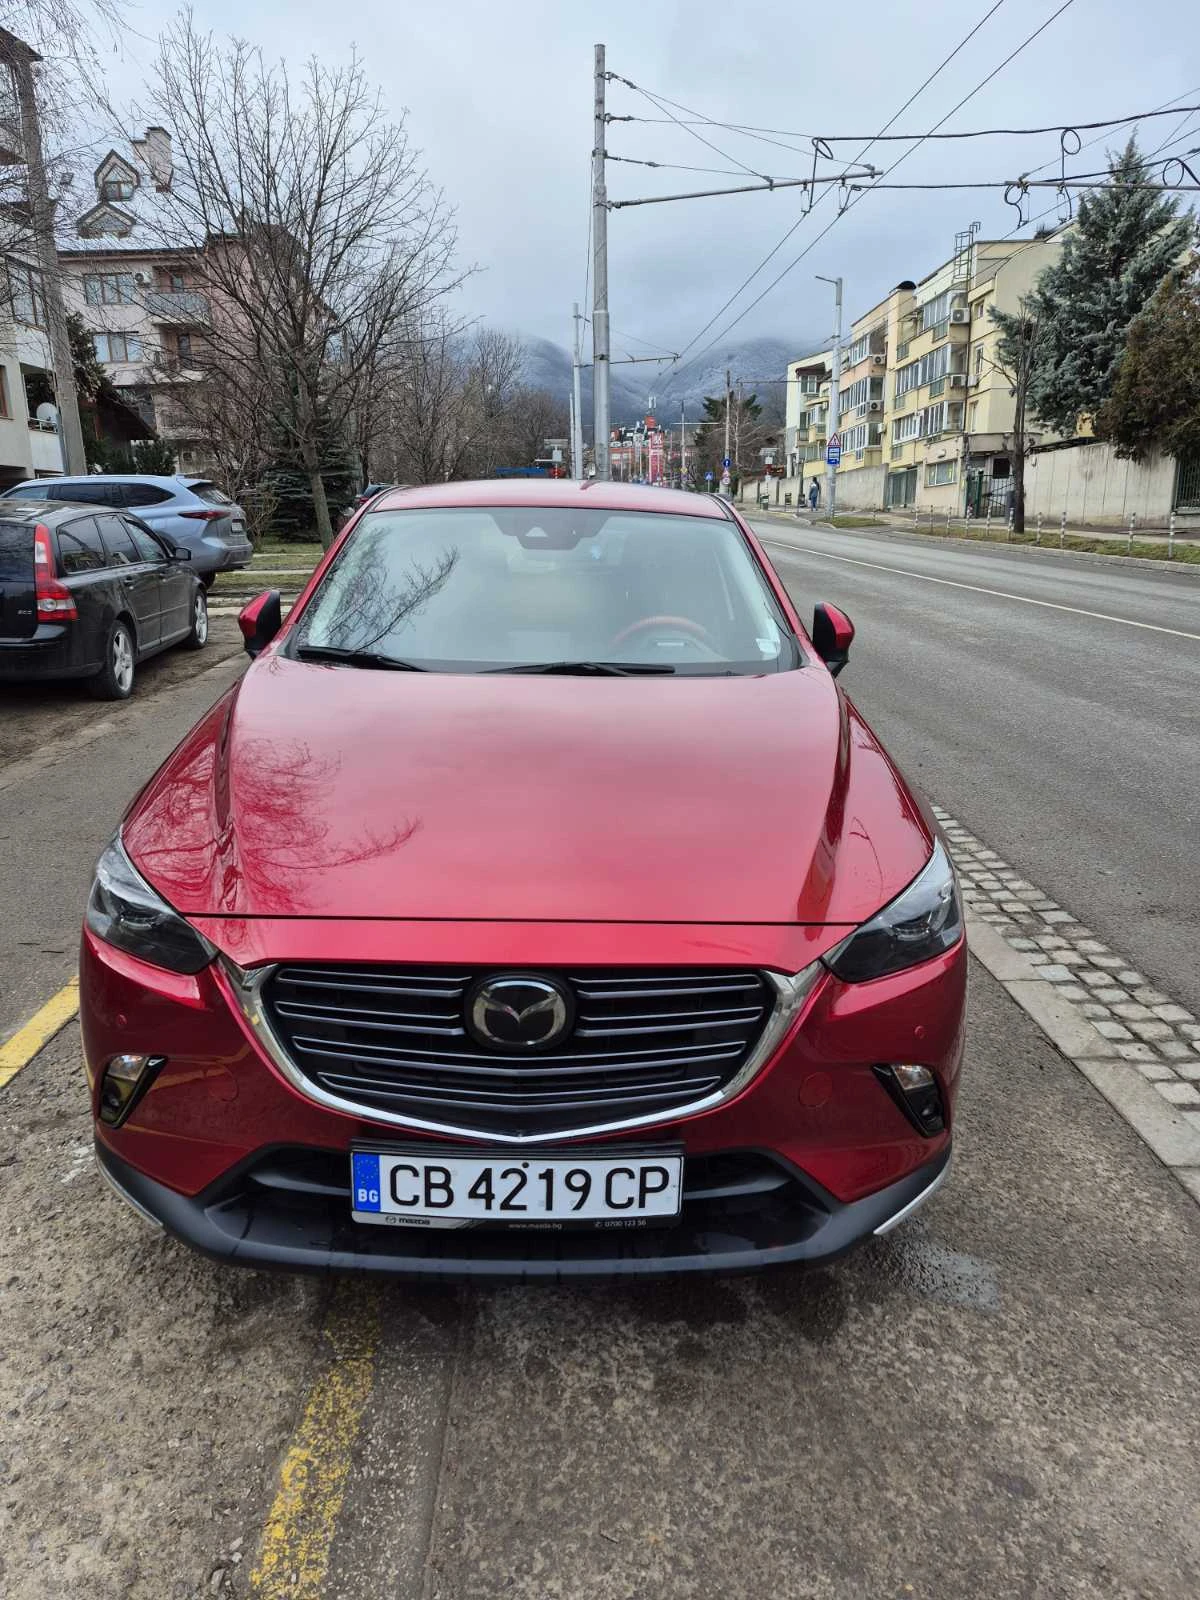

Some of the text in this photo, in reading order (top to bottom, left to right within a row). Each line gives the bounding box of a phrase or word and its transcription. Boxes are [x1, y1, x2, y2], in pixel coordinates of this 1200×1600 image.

[358, 1189, 379, 1203] BG
[390, 1164, 670, 1211] CB 4219 CP
